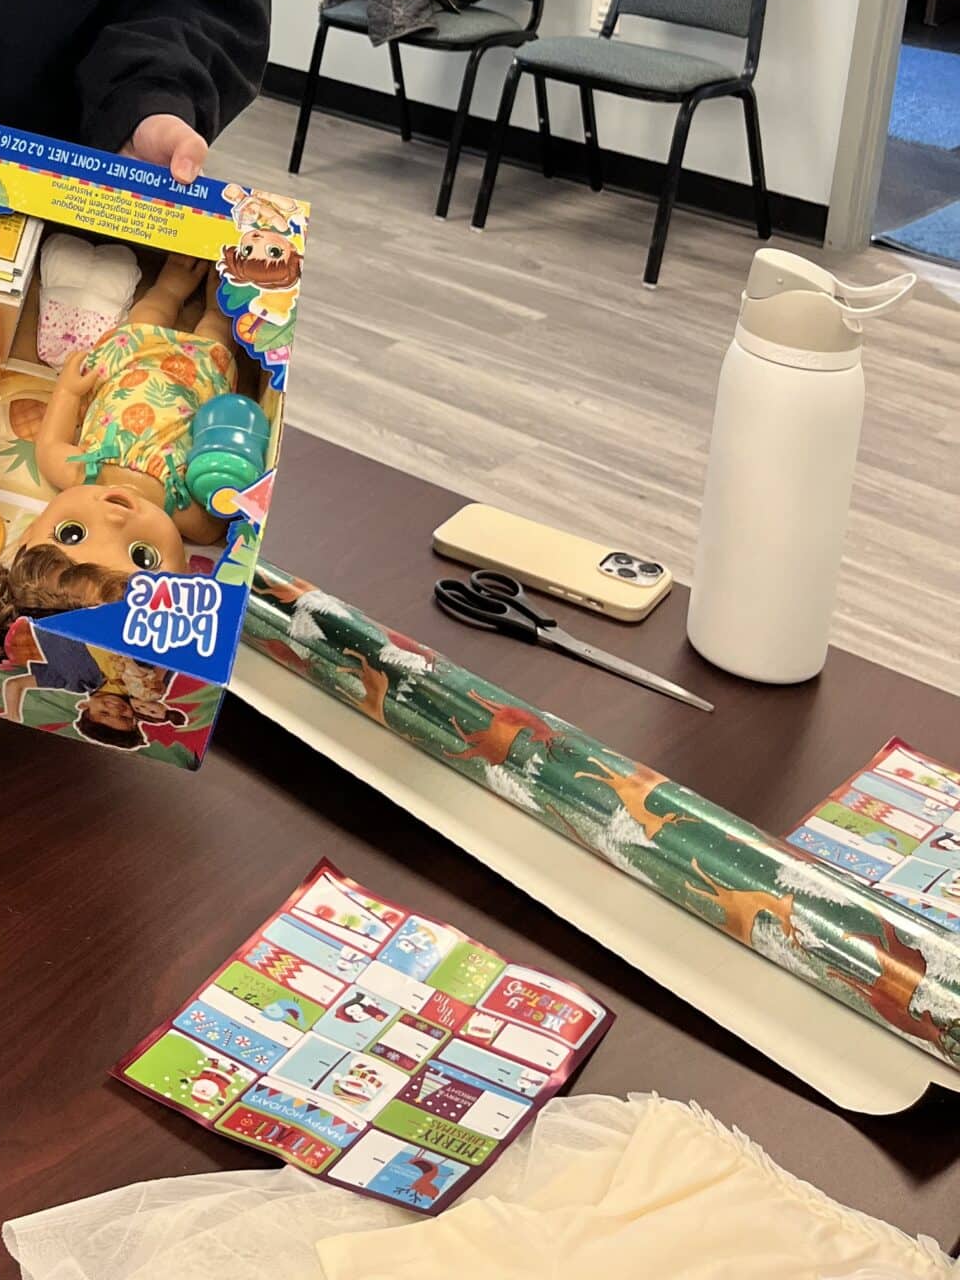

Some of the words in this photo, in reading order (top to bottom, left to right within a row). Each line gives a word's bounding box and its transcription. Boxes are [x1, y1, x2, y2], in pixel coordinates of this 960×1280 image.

[0, 134, 12, 148] (6
[12, 138, 26, 152] OZ
[28, 142, 44, 156] 0.2
[48, 148, 69, 162] NET.
[71, 152, 100, 171] CONT.
[107, 162, 128, 178] NET
[130, 167, 160, 186] POIDS
[188, 182, 209, 199] NET
[75, 214, 95, 224] Baby
[97, 221, 119, 231] Mixer
[121, 226, 152, 239] Magical
[131, 578, 217, 617] alive
[126, 607, 214, 653] baby
[250, 1095, 305, 1119] HOLIDAYS
[304, 1117, 344, 1141] HAPPY
[431, 1120, 486, 1146] CHRISTMAS
[419, 1129, 480, 1158] MERRY
